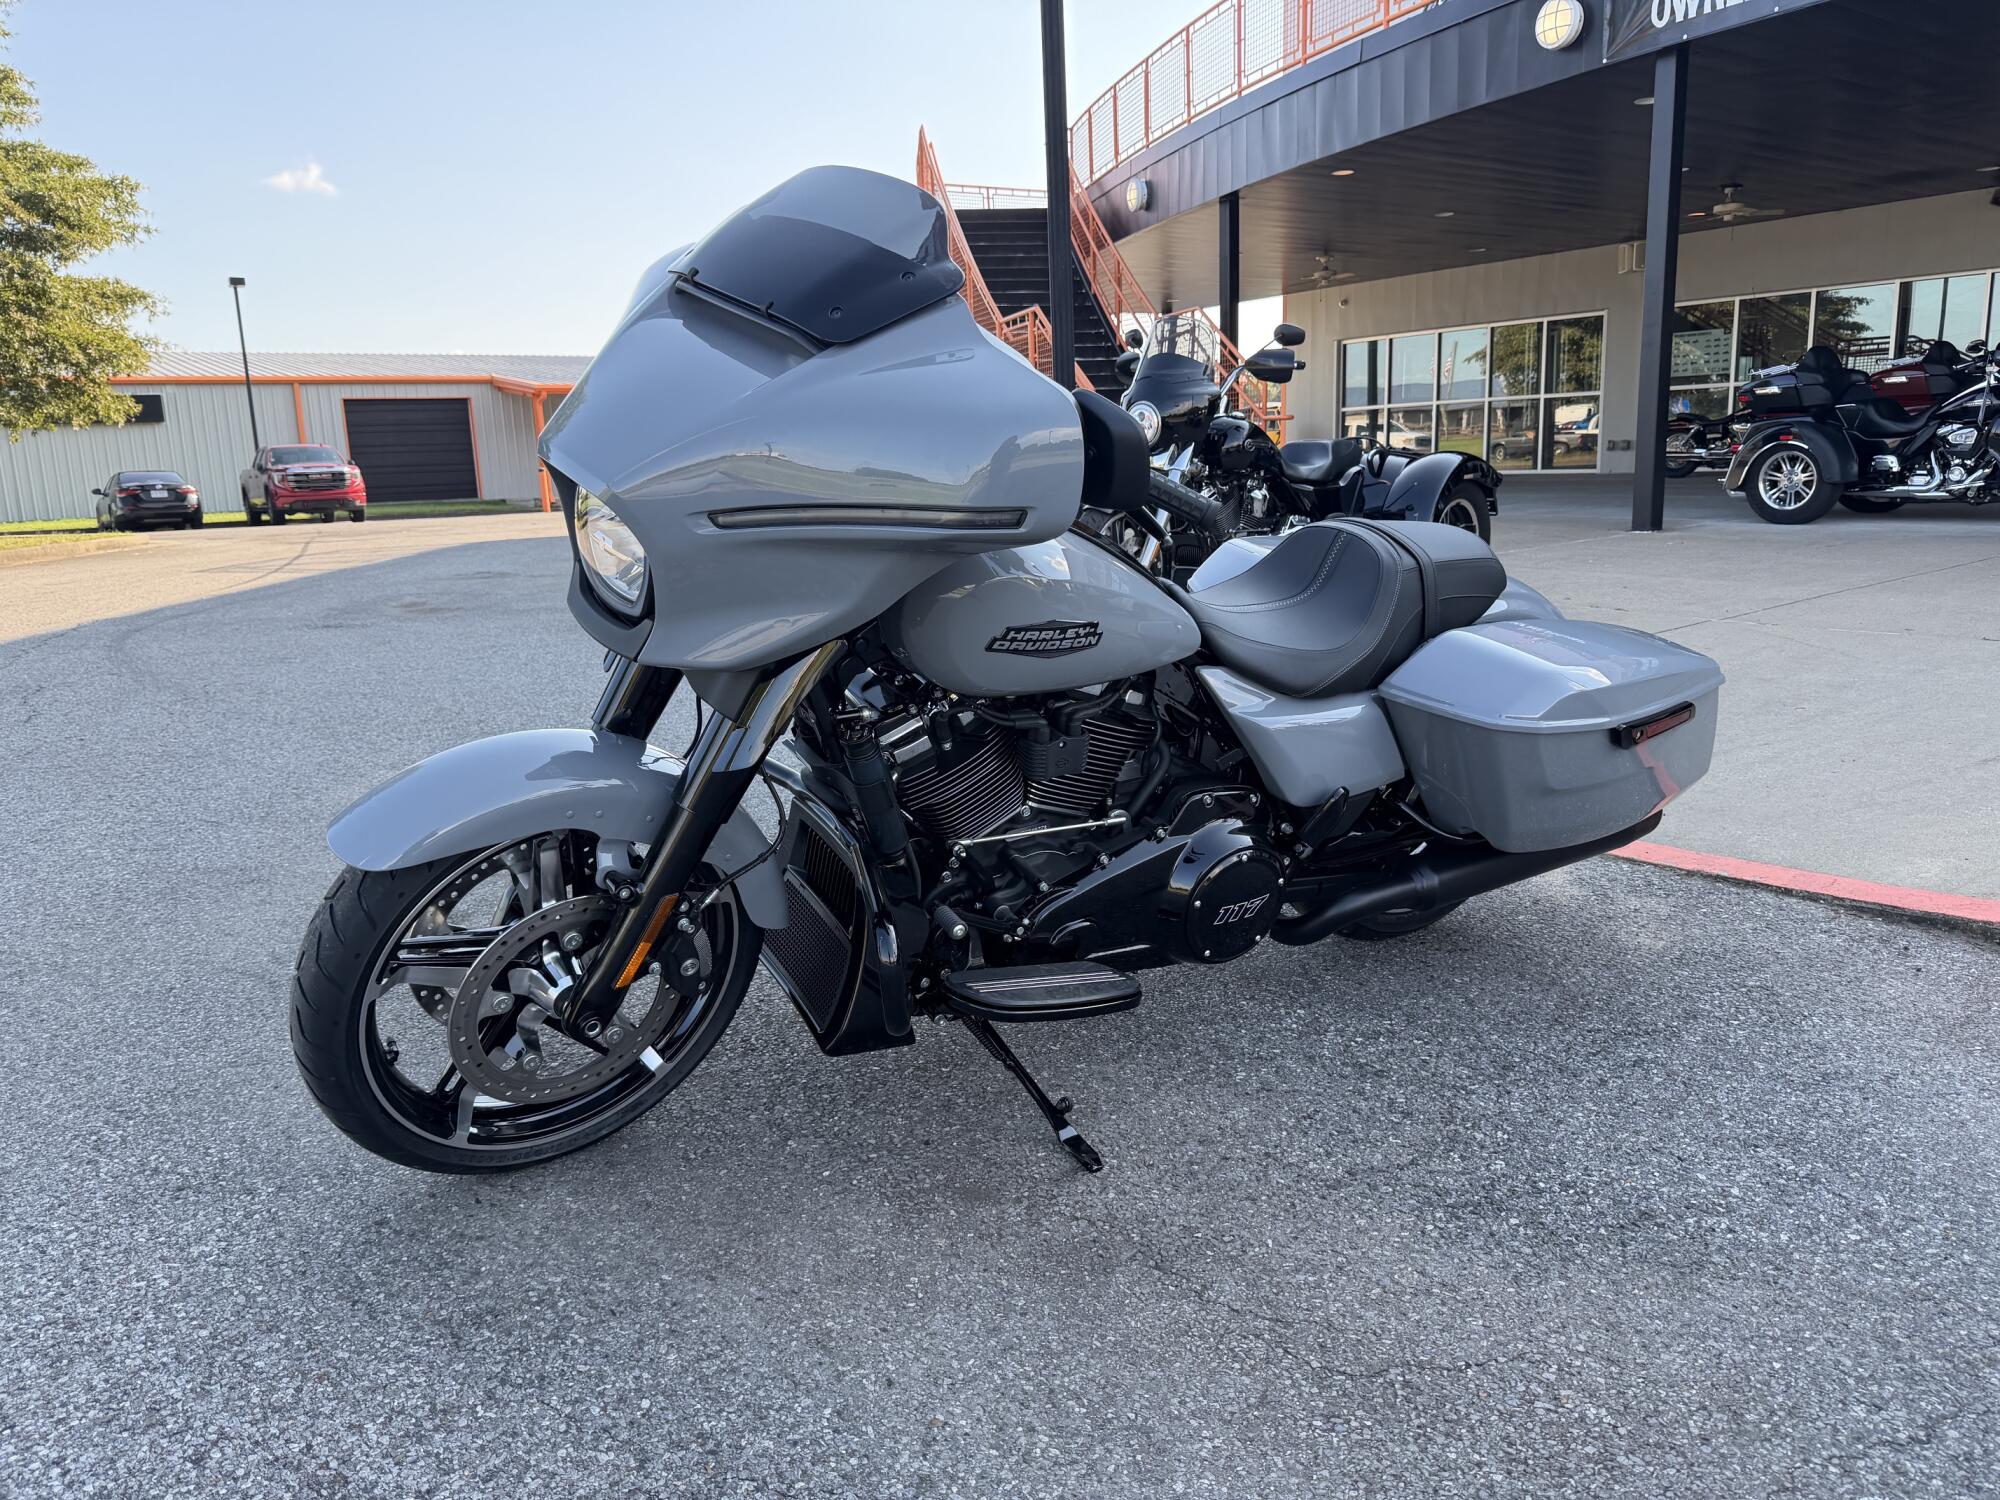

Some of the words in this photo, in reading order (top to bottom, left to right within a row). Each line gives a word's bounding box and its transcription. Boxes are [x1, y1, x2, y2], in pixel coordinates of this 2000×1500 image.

[1006, 626, 1095, 641] HARLEY-
[991, 635, 1099, 650] DAVIDSON
[1213, 893, 1270, 925] 117
